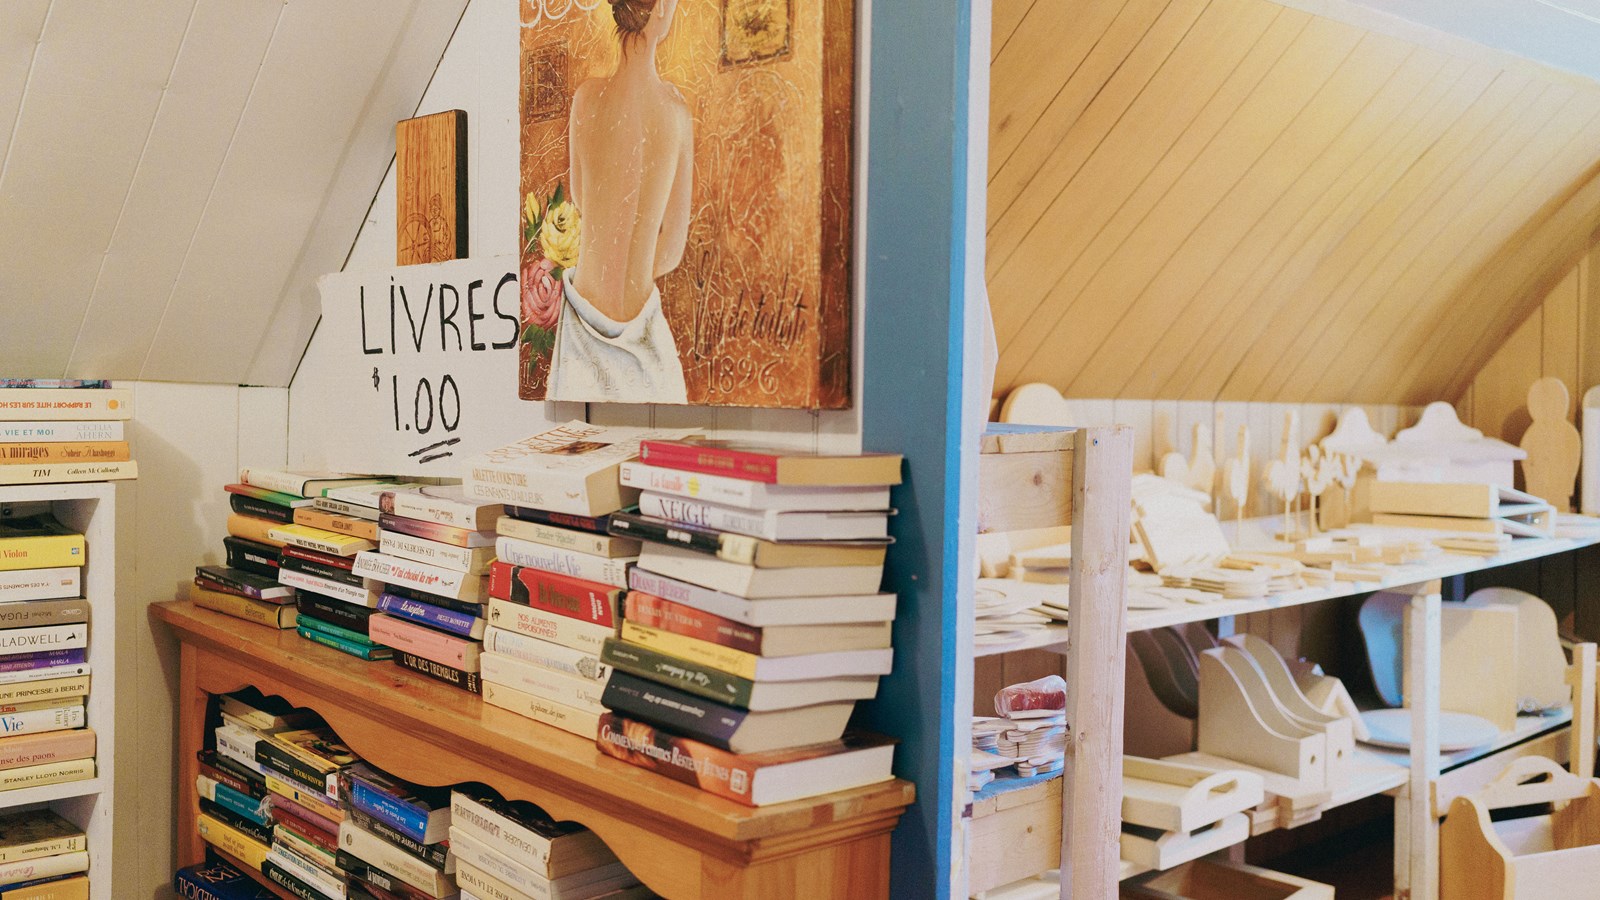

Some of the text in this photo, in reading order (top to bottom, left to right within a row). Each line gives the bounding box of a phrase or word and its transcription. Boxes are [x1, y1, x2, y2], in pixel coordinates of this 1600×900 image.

[360, 272, 520, 355] LIVRES
[706, 354, 779, 396] 1896
[10, 444, 49, 461] mirages
[33, 469, 51, 477] TIM
[658, 498, 712, 528] NEIGE
[4, 549, 28, 559] Violon
[504, 542, 524, 563] Une
[525, 552, 565, 572] nouvelle
[517, 613, 558, 631] NOS ALIMENTS
[403, 653, 417, 668] L'OR
[417, 658, 429, 674] DES
[429, 661, 460, 684] TREMBLES
[16, 687, 53, 698] PRINCESSE
[60, 684, 85, 692] BERLIN
[2, 716, 24, 733] Vie
[17, 754, 30, 763] des
[32, 752, 56, 762] paons
[4, 768, 84, 784] STANLEY LLOYD NORRIS
[401, 838, 417, 852] veuve
[418, 845, 427, 858] La
